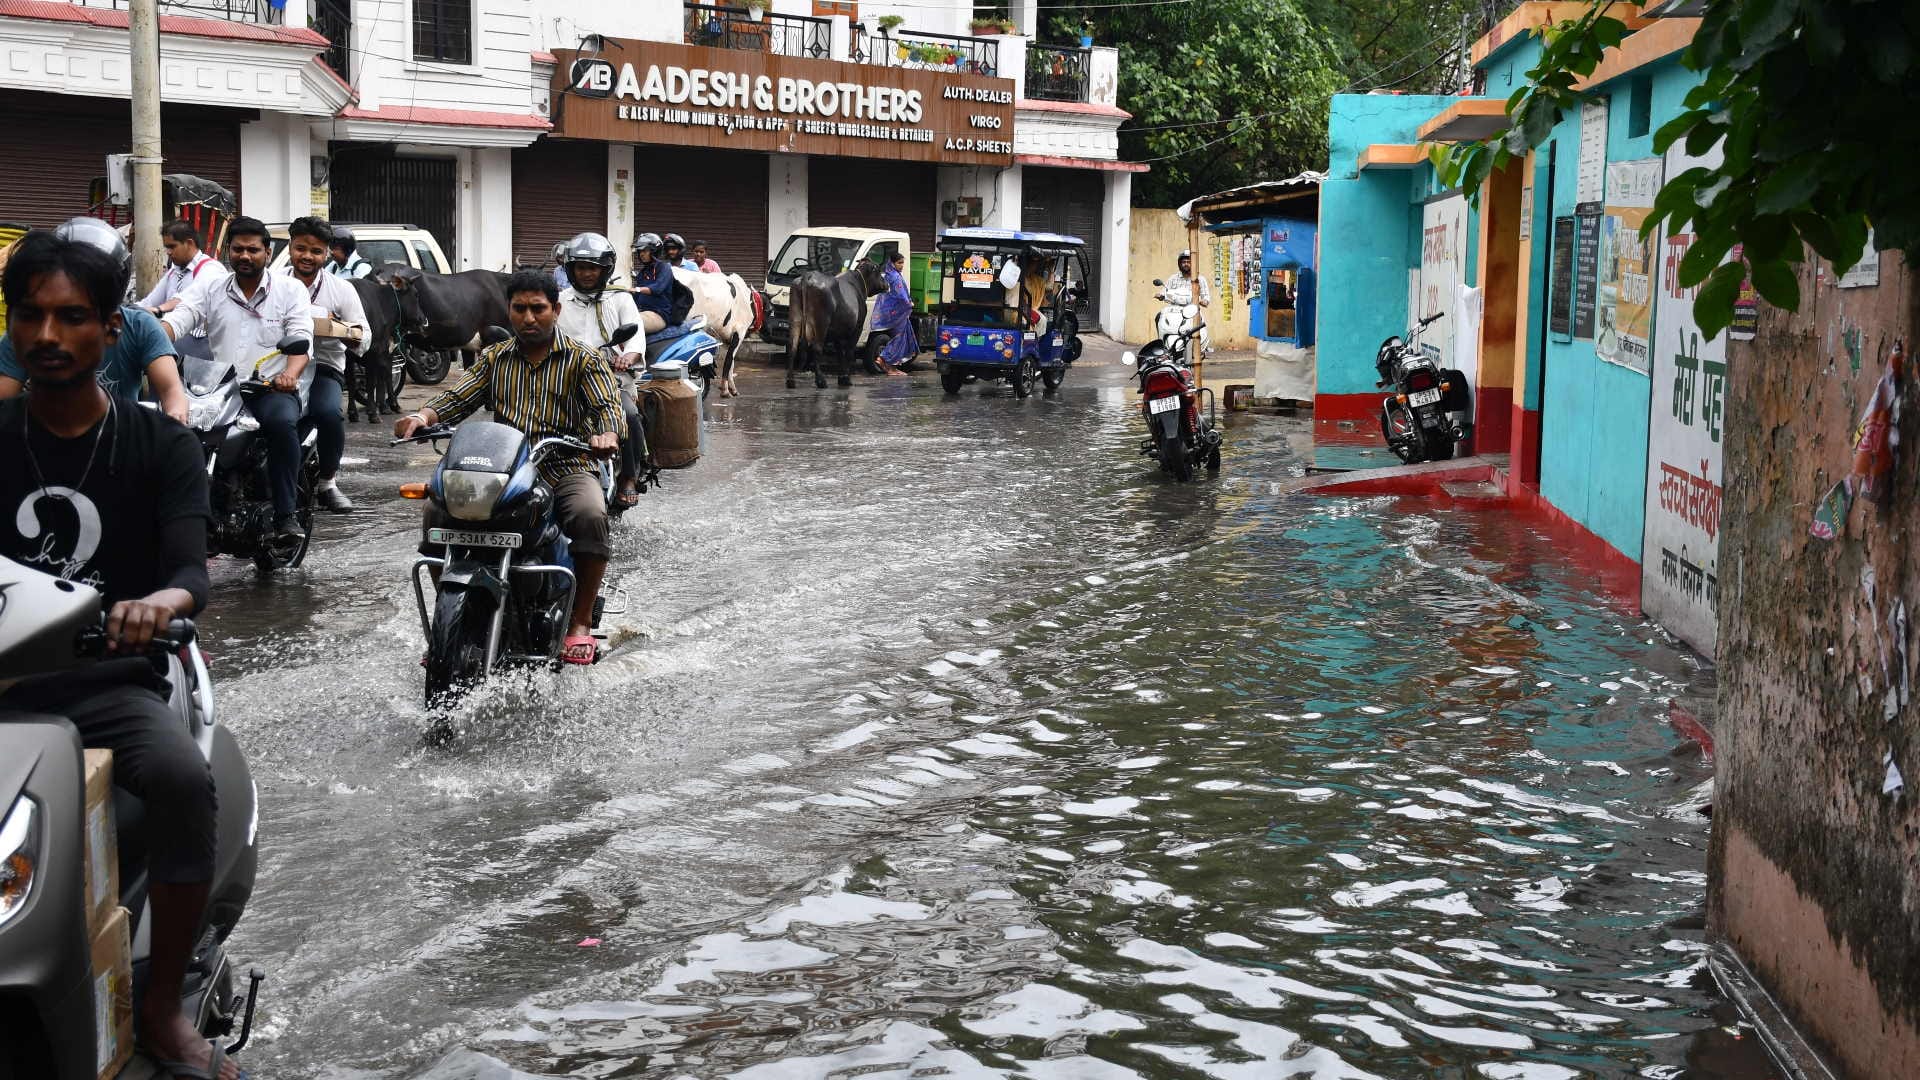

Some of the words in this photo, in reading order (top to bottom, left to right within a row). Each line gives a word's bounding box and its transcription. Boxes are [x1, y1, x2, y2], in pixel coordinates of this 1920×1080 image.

[616, 62, 749, 109] AADESH
[753, 75, 774, 111] &
[778, 77, 923, 123] BROTHERS
[943, 86, 974, 100] AUTH.
[976, 89, 1012, 104] DEALER
[970, 115, 1001, 128] VIRGO
[838, 122, 889, 139] WHOLESALER
[900, 128, 934, 142] RETAILER
[976, 141, 1012, 153] SHEETS
[1673, 325, 1698, 427] मेरी
[1702, 359, 1727, 443] पह
[441, 532, 454, 543] UP
[460, 533, 487, 545] 53AK
[491, 534, 518, 546] 5241
